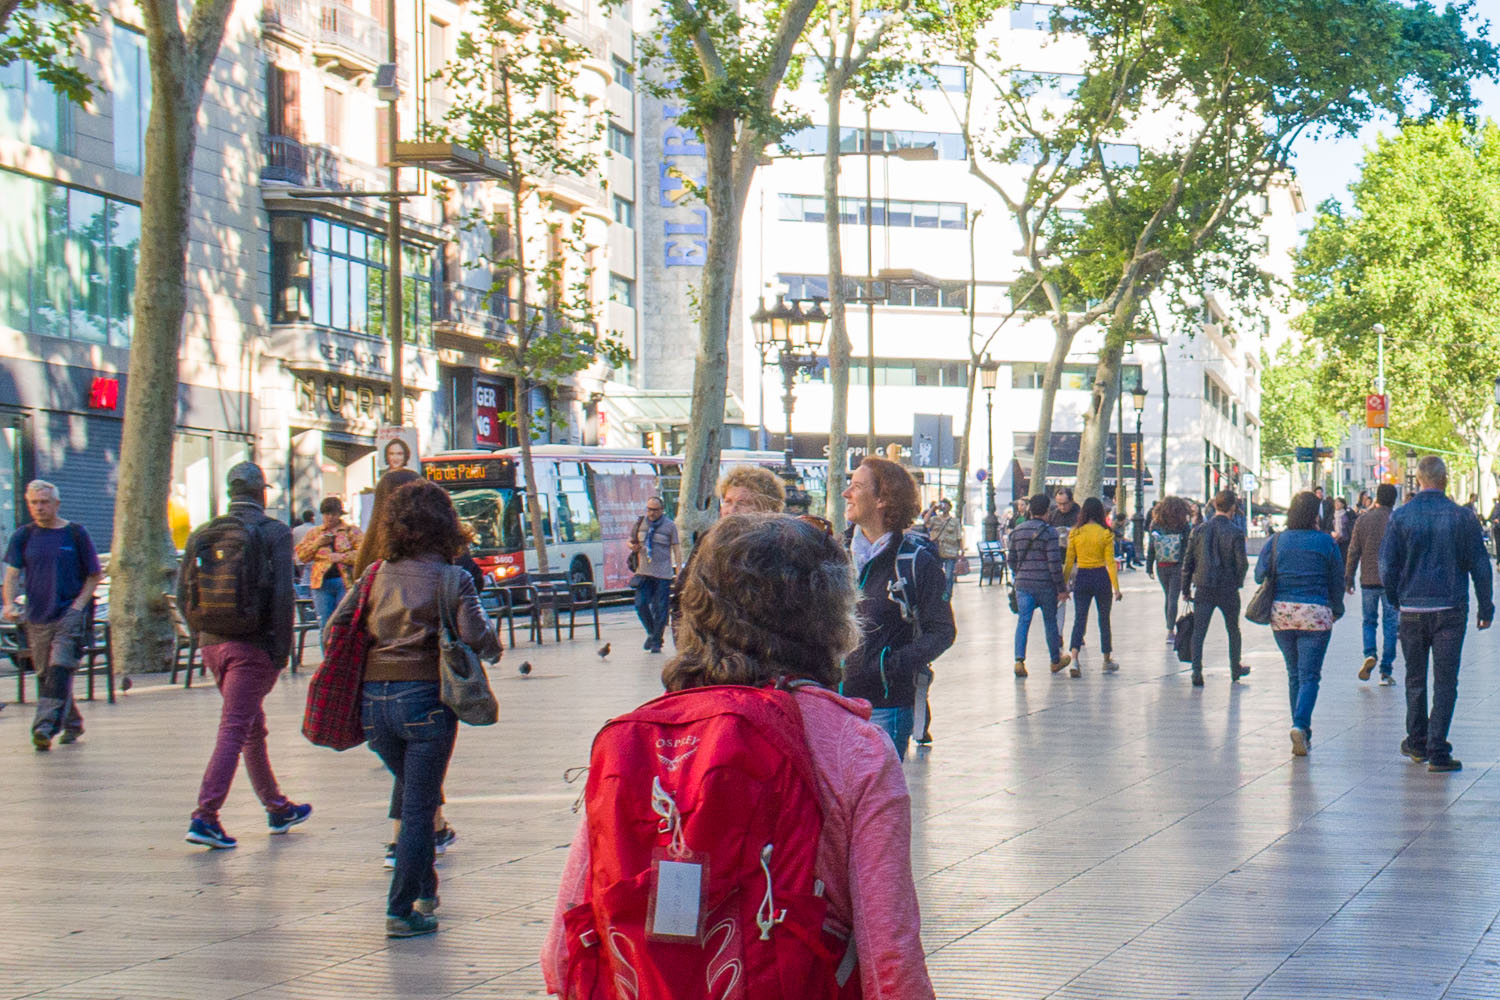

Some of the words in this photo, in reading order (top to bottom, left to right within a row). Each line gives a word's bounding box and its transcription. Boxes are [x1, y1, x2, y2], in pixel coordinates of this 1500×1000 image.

[664, 210, 707, 268] EL
[822, 444, 885, 457] SPPIG
[426, 465, 443, 481] Pla
[445, 465, 458, 480] de
